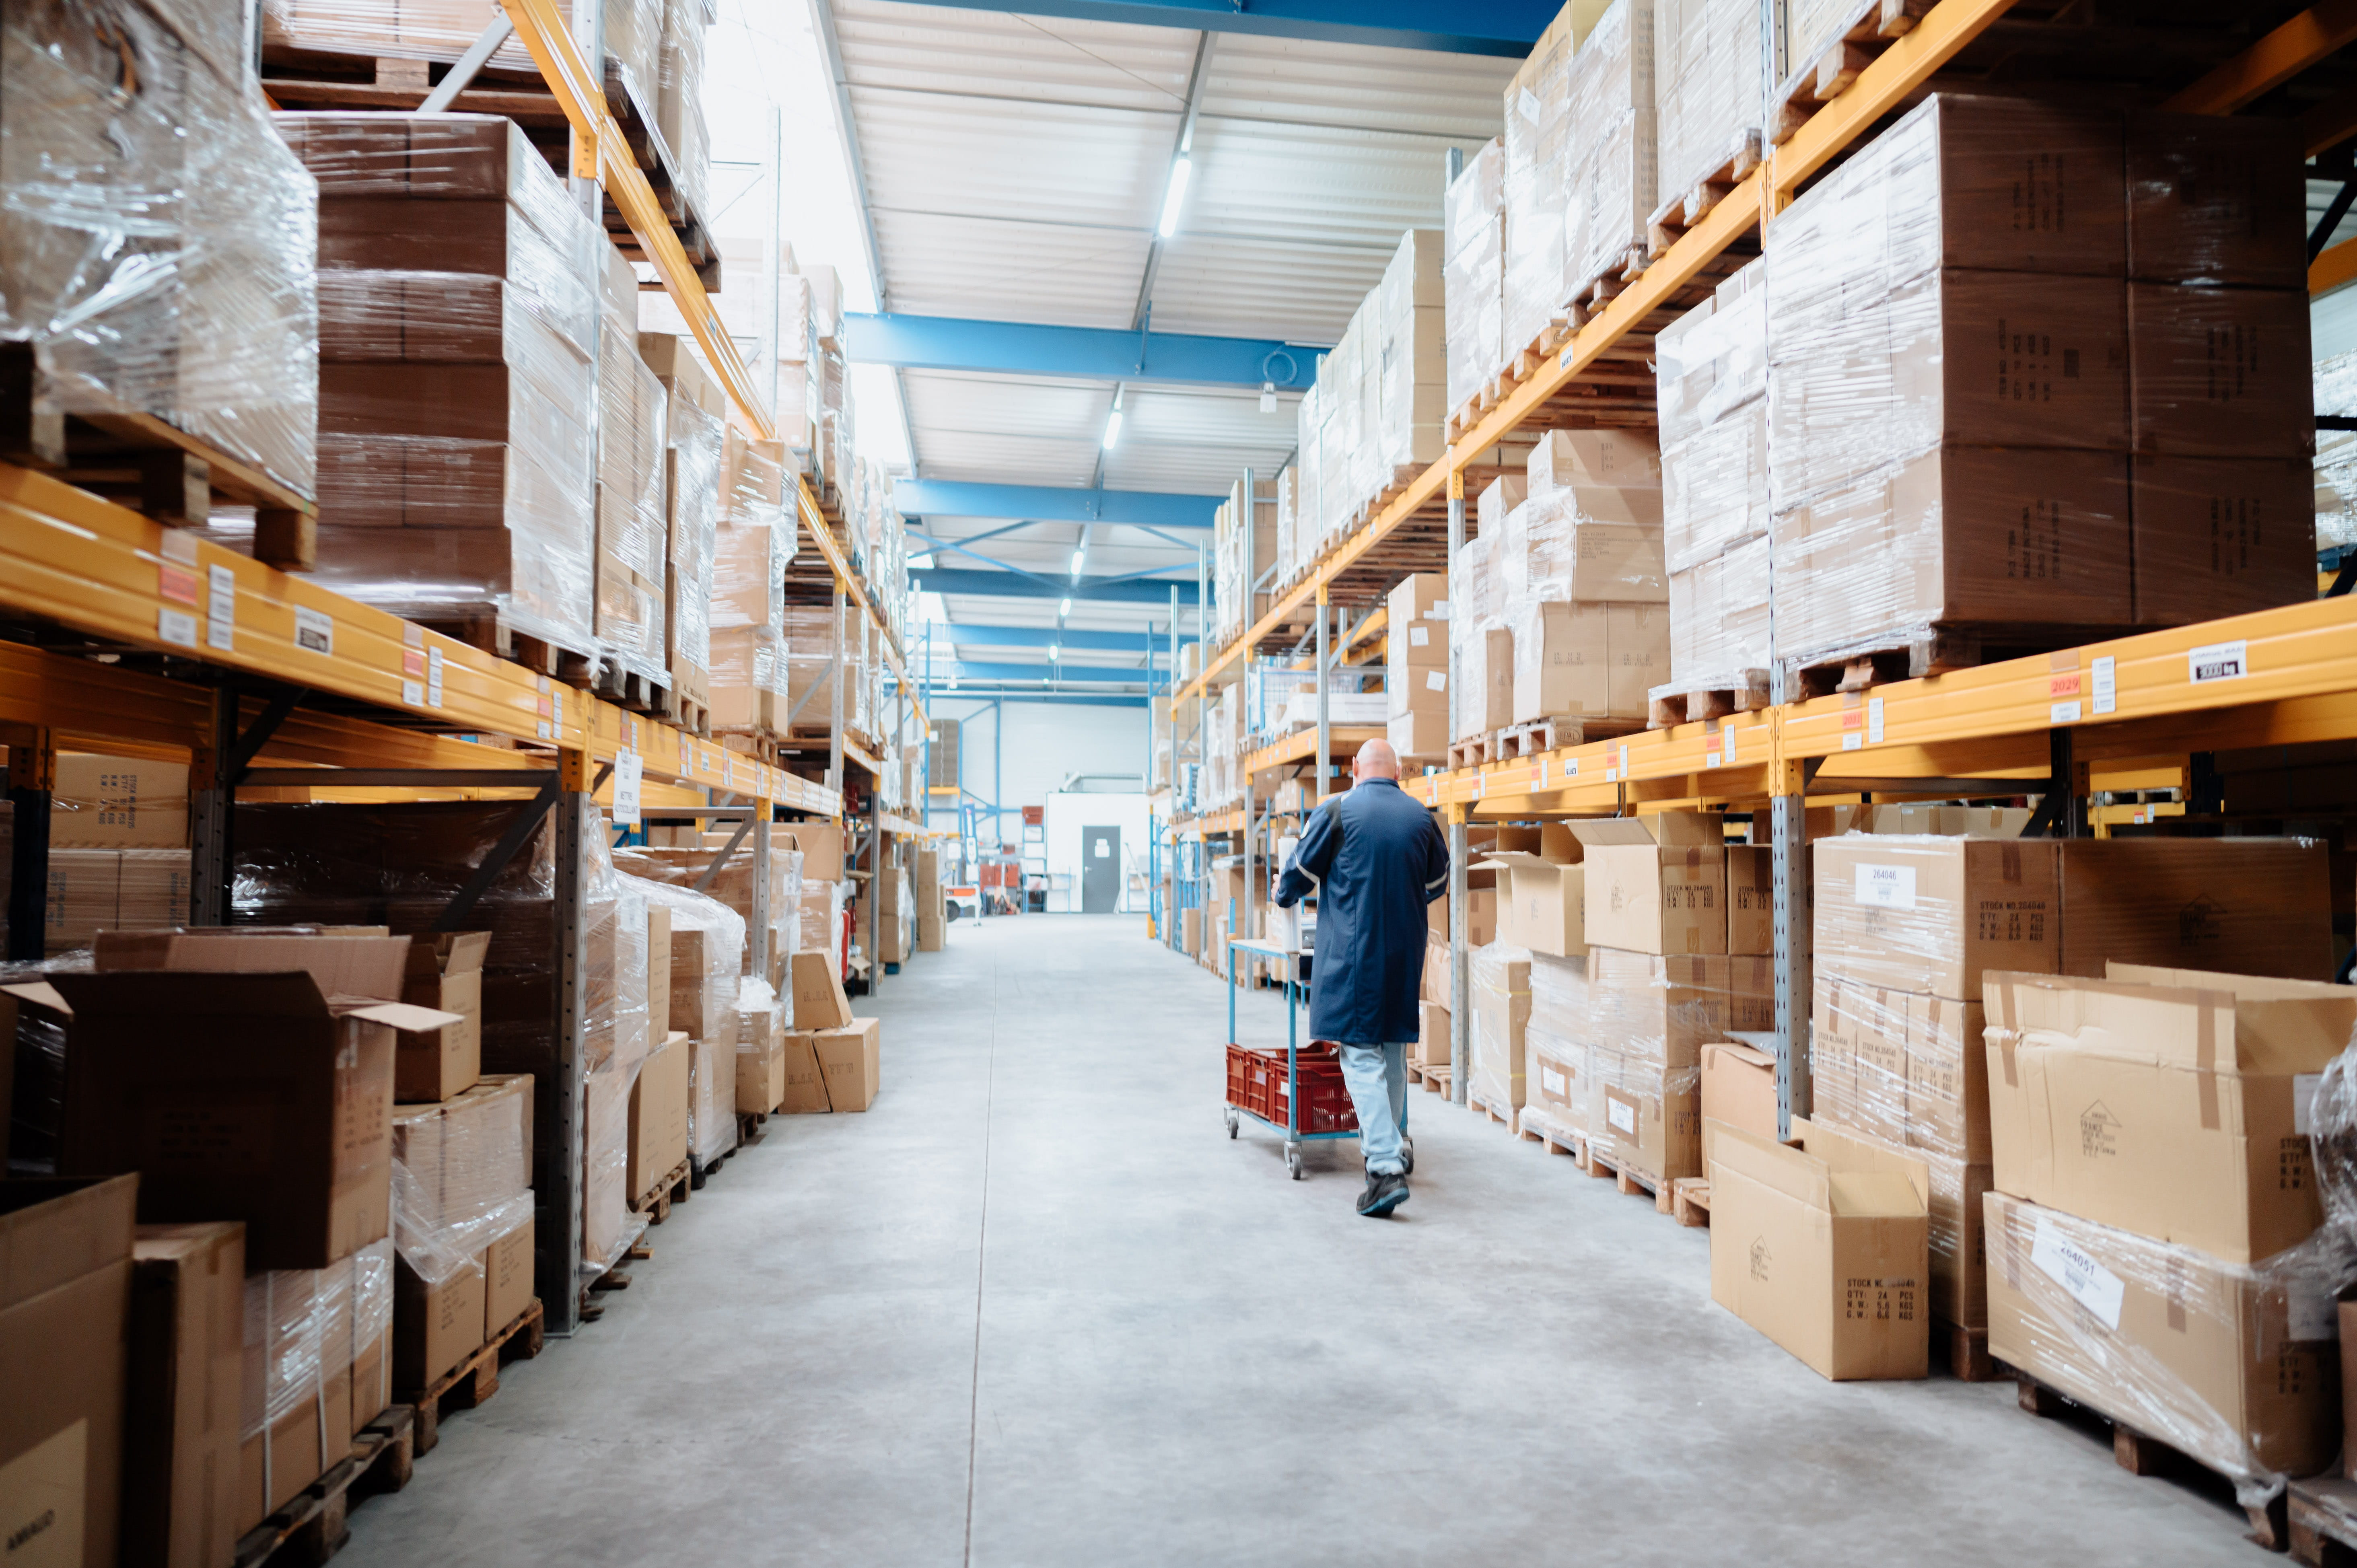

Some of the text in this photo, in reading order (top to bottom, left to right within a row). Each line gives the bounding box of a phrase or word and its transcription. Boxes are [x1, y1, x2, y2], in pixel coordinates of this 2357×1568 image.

[2199, 662, 2236, 679] 3000 kg
[2052, 678, 2079, 692] 2029
[1843, 714, 1862, 728] 2031
[1873, 869, 1897, 880] 264046
[1980, 901, 2003, 910] STOCK
[2009, 912, 2019, 922] 24
[2030, 913, 2044, 922] PCS
[2030, 923, 2044, 932] KGS
[2029, 932, 2043, 941] KGS
[1818, 1031, 1828, 1041] STOCK
[1863, 1041, 1874, 1052] STOCK
[1876, 1056, 1881, 1064] 24
[1931, 1070, 1936, 1078] 24
[1943, 1072, 1952, 1082] PCS
[2061, 1241, 2095, 1276] 264051
[1847, 1278, 1871, 1288] STOCK
[1877, 1291, 1888, 1300] 24
[1900, 1290, 1914, 1300] PCS
[1899, 1301, 1913, 1311] KGS
[1898, 1311, 1913, 1321] KGS
